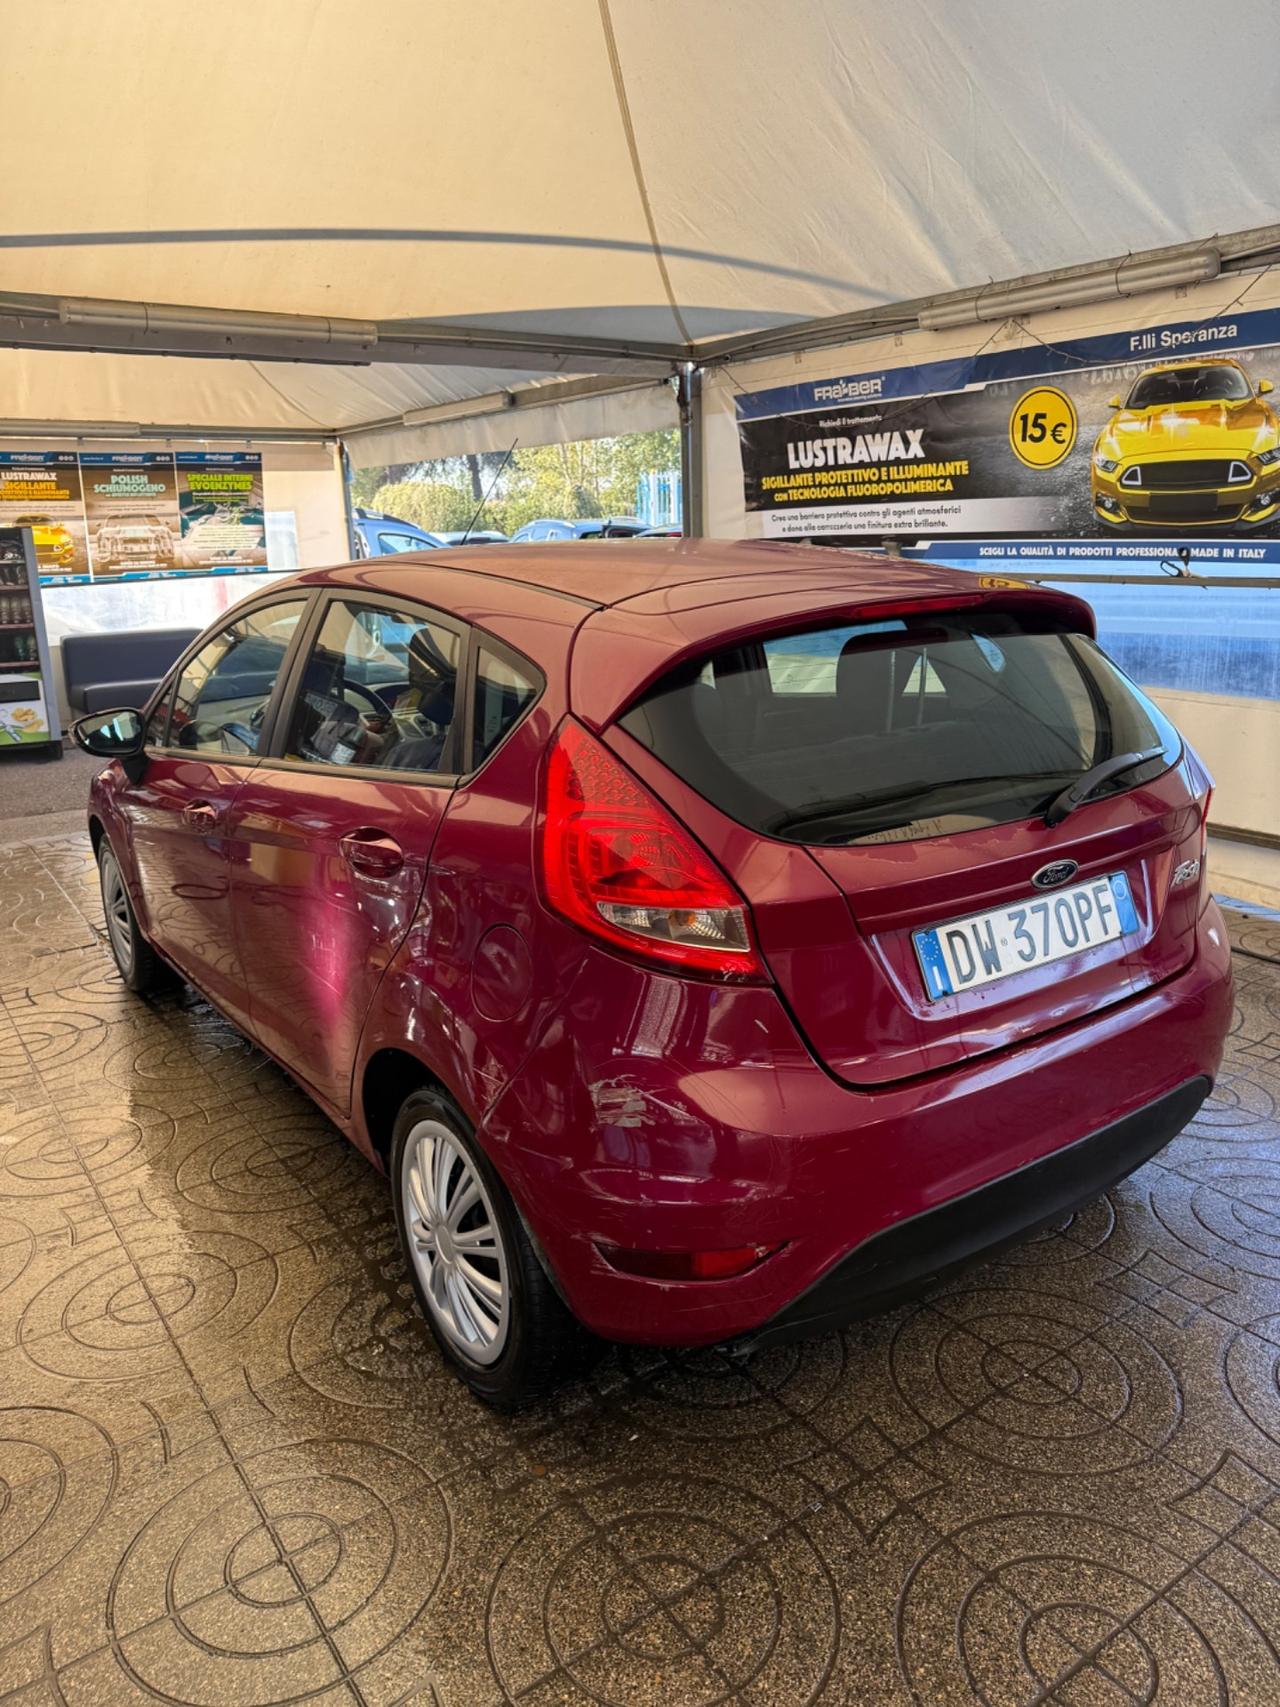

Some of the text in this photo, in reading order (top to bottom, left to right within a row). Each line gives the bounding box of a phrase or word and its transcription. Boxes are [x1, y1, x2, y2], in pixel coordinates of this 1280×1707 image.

[1160, 324, 1238, 349] Speranza
[1019, 412, 1047, 443] 15
[786, 428, 926, 470] LUSTRAWAX
[0, 472, 58, 481] LUSTRAWAX
[110, 475, 149, 484] POLISH
[761, 460, 970, 490] SIGILLANTE PROTETTIVO E ILLUMINANTE
[93, 484, 166, 494] SCHIUMOGENO
[788, 485, 846, 501] TECNOLOGIA
[846, 478, 954, 497] FLUOROPOLIMERICA
[799, 511, 825, 520] barriera
[826, 510, 858, 521] protettiva
[881, 507, 891, 519] gli
[892, 506, 916, 519] agenti
[917, 504, 962, 516] atmosferici
[867, 520, 892, 529] finitura
[893, 521, 913, 529] extra
[914, 518, 948, 528] brillante.
[979, 545, 1267, 558] SCEGLI LA QUALITÀ DI PRODOTTI PROFESSIONA MADE IN ITALY
[946, 883, 1113, 985] DW 370PF
